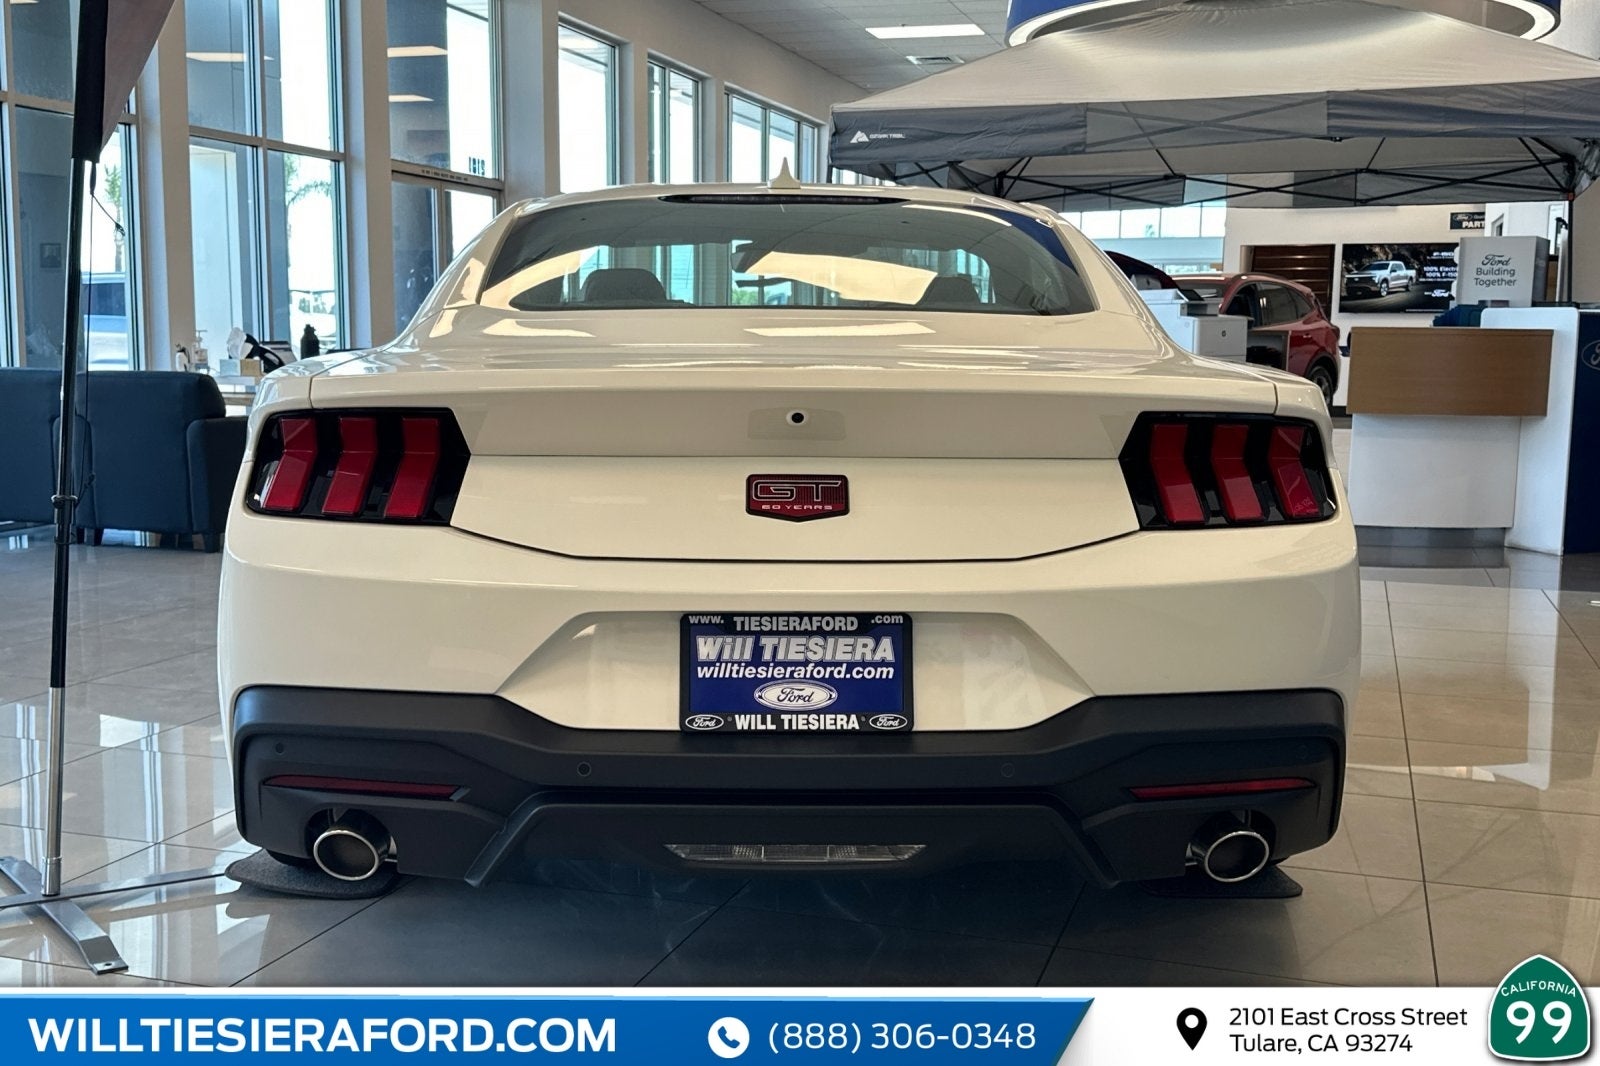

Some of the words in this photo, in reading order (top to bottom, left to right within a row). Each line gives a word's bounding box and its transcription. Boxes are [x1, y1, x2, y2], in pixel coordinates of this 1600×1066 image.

[1462, 221, 1485, 229] PART
[1482, 253, 1511, 266] Ford
[1476, 267, 1515, 277] Building
[1474, 278, 1517, 288] Together
[753, 480, 841, 501] GT
[689, 615, 724, 624] www.
[733, 616, 859, 631] TIESIERAFORD
[871, 615, 904, 624] .com
[696, 635, 755, 662] Will
[759, 635, 896, 662] TIESIERA
[697, 663, 894, 679] willtiesieraford.com
[777, 687, 814, 703] Ford
[692, 716, 716, 727] Ford
[735, 714, 777, 729] WILL
[781, 714, 860, 730] TIESIERA
[876, 715, 900, 727] Ford
